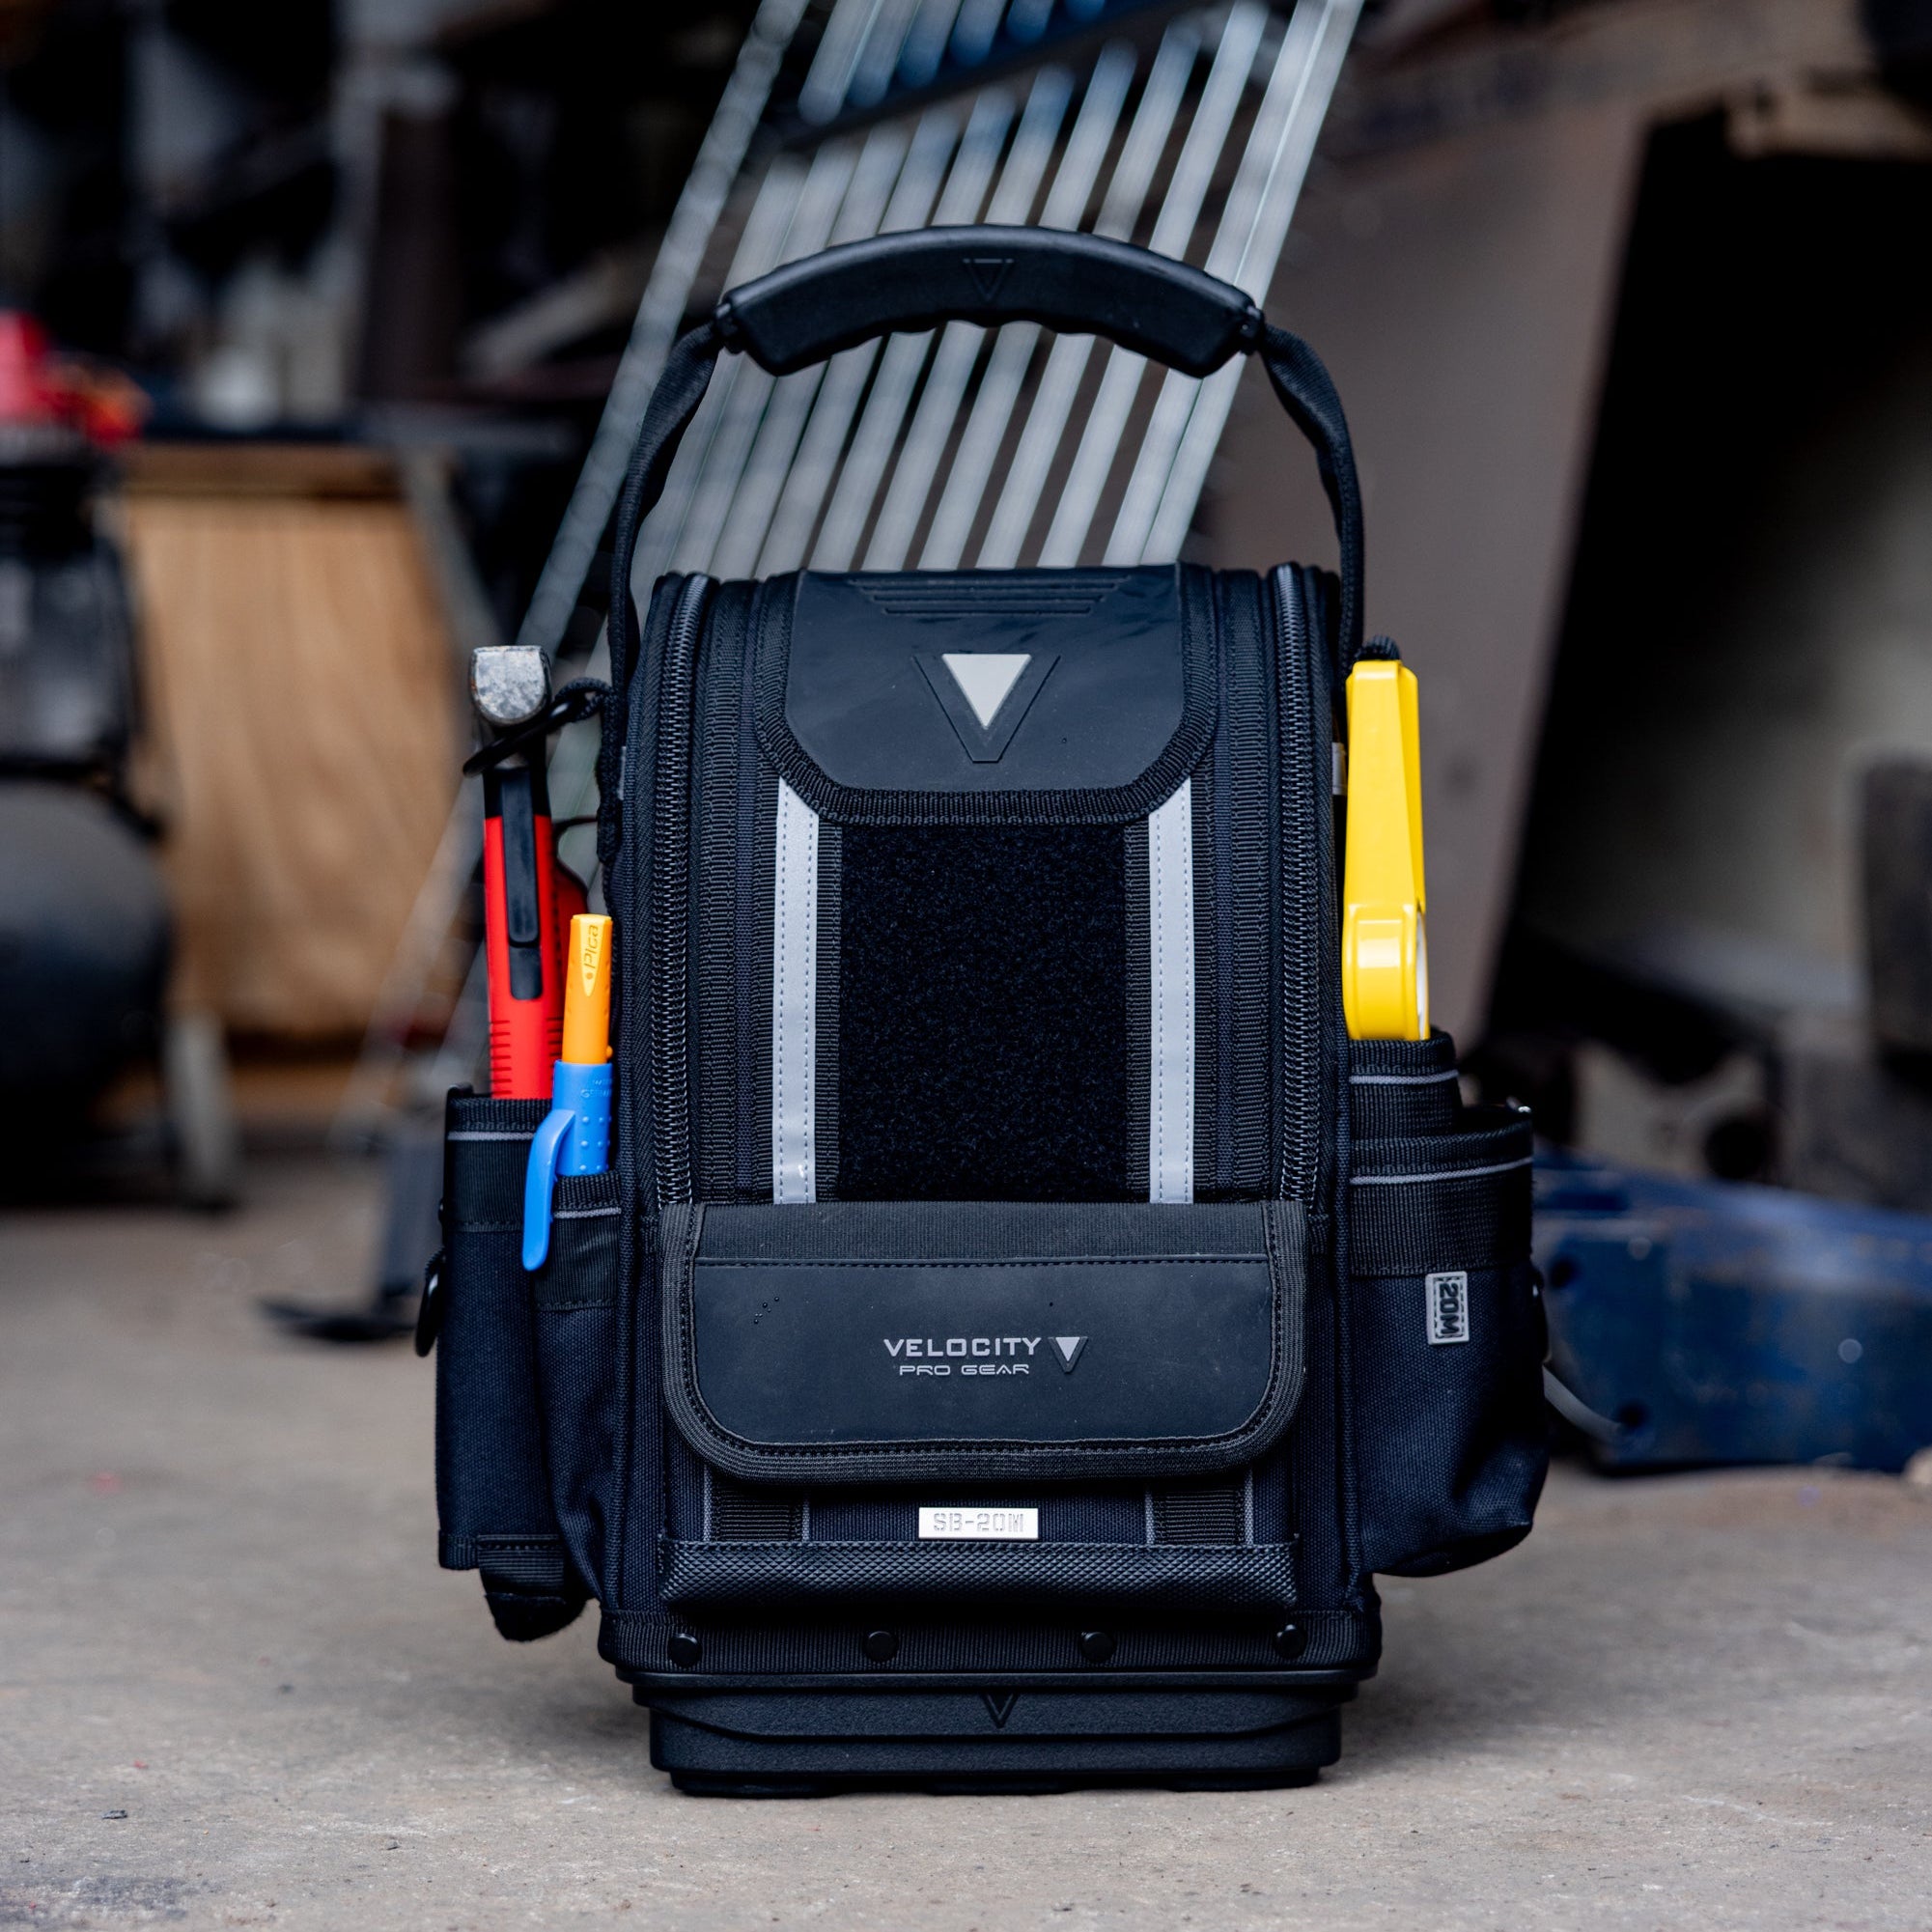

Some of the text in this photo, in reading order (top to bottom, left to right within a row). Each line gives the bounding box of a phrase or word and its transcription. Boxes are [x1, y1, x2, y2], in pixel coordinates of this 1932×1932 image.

[1440, 1282, 1461, 1334] 20M
[883, 1336, 1042, 1358] VELOCITY
[899, 1363, 1030, 1376] PRO GEAR
[933, 1512, 1024, 1533] SB-20M
